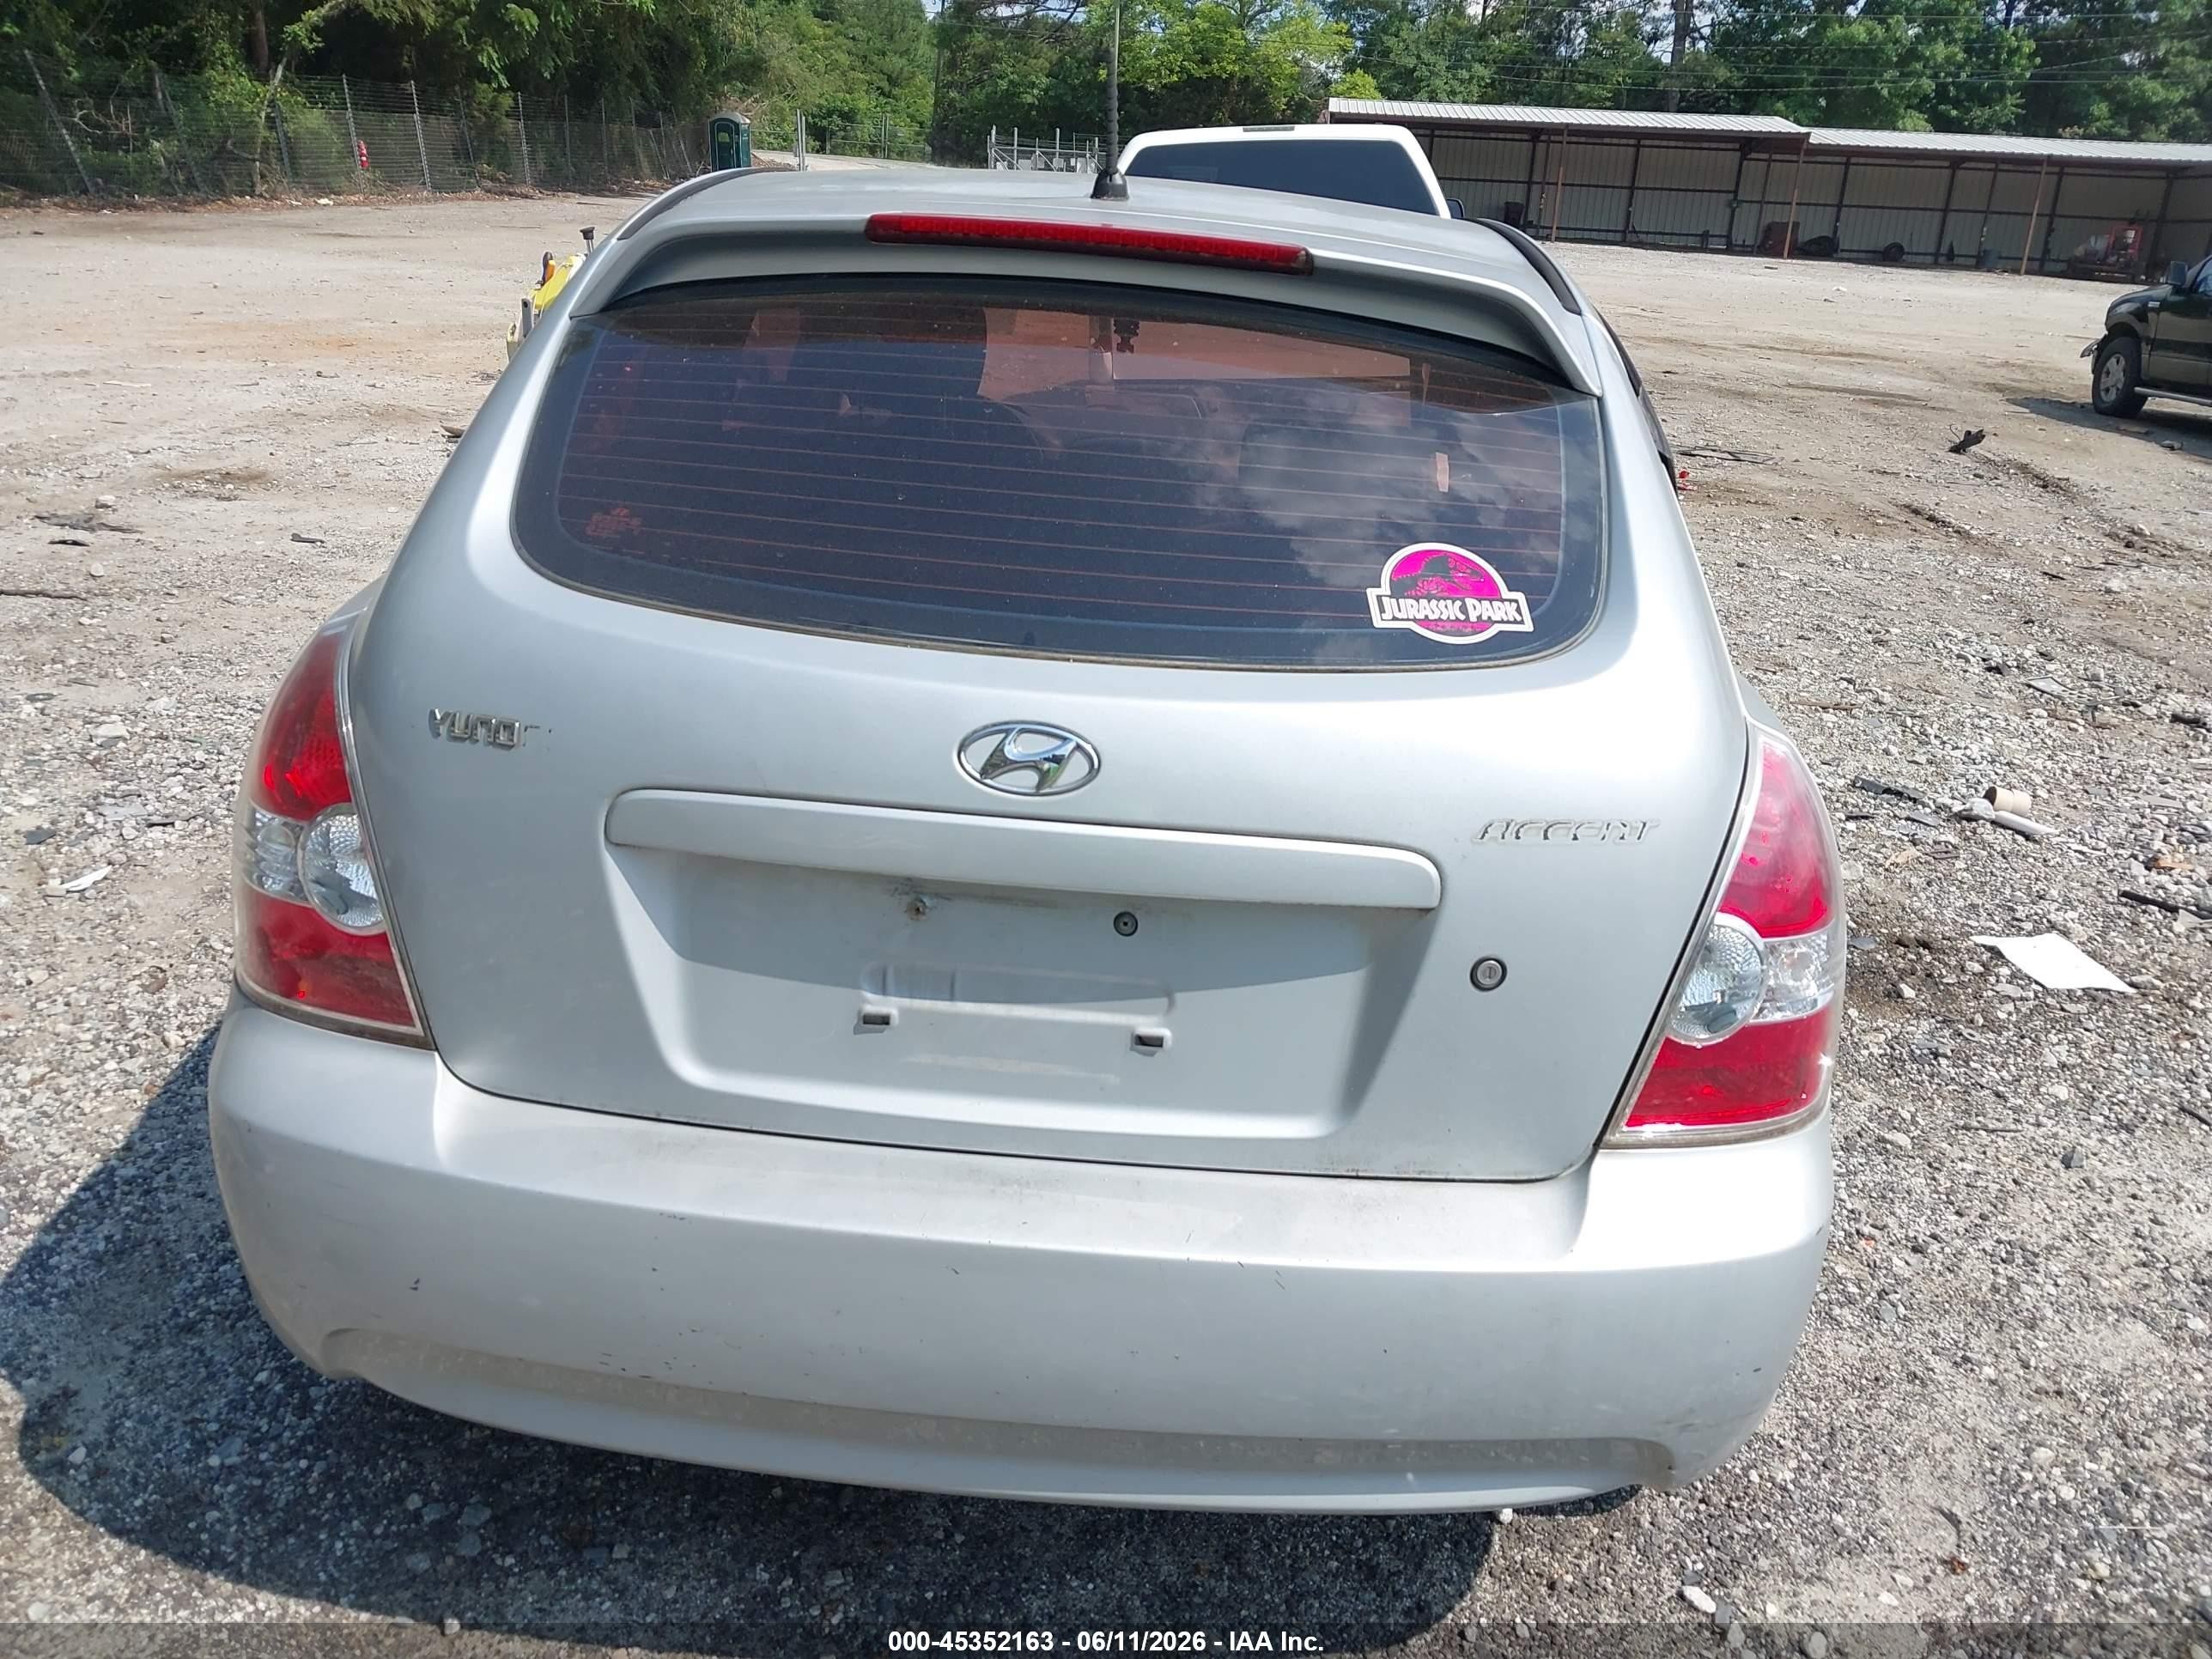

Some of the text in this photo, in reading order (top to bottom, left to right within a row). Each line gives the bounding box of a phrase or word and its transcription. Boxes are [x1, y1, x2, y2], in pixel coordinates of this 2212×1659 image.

[1381, 596, 1523, 622] JURASSIC PARK
[1470, 817, 1661, 844] ACCENT
